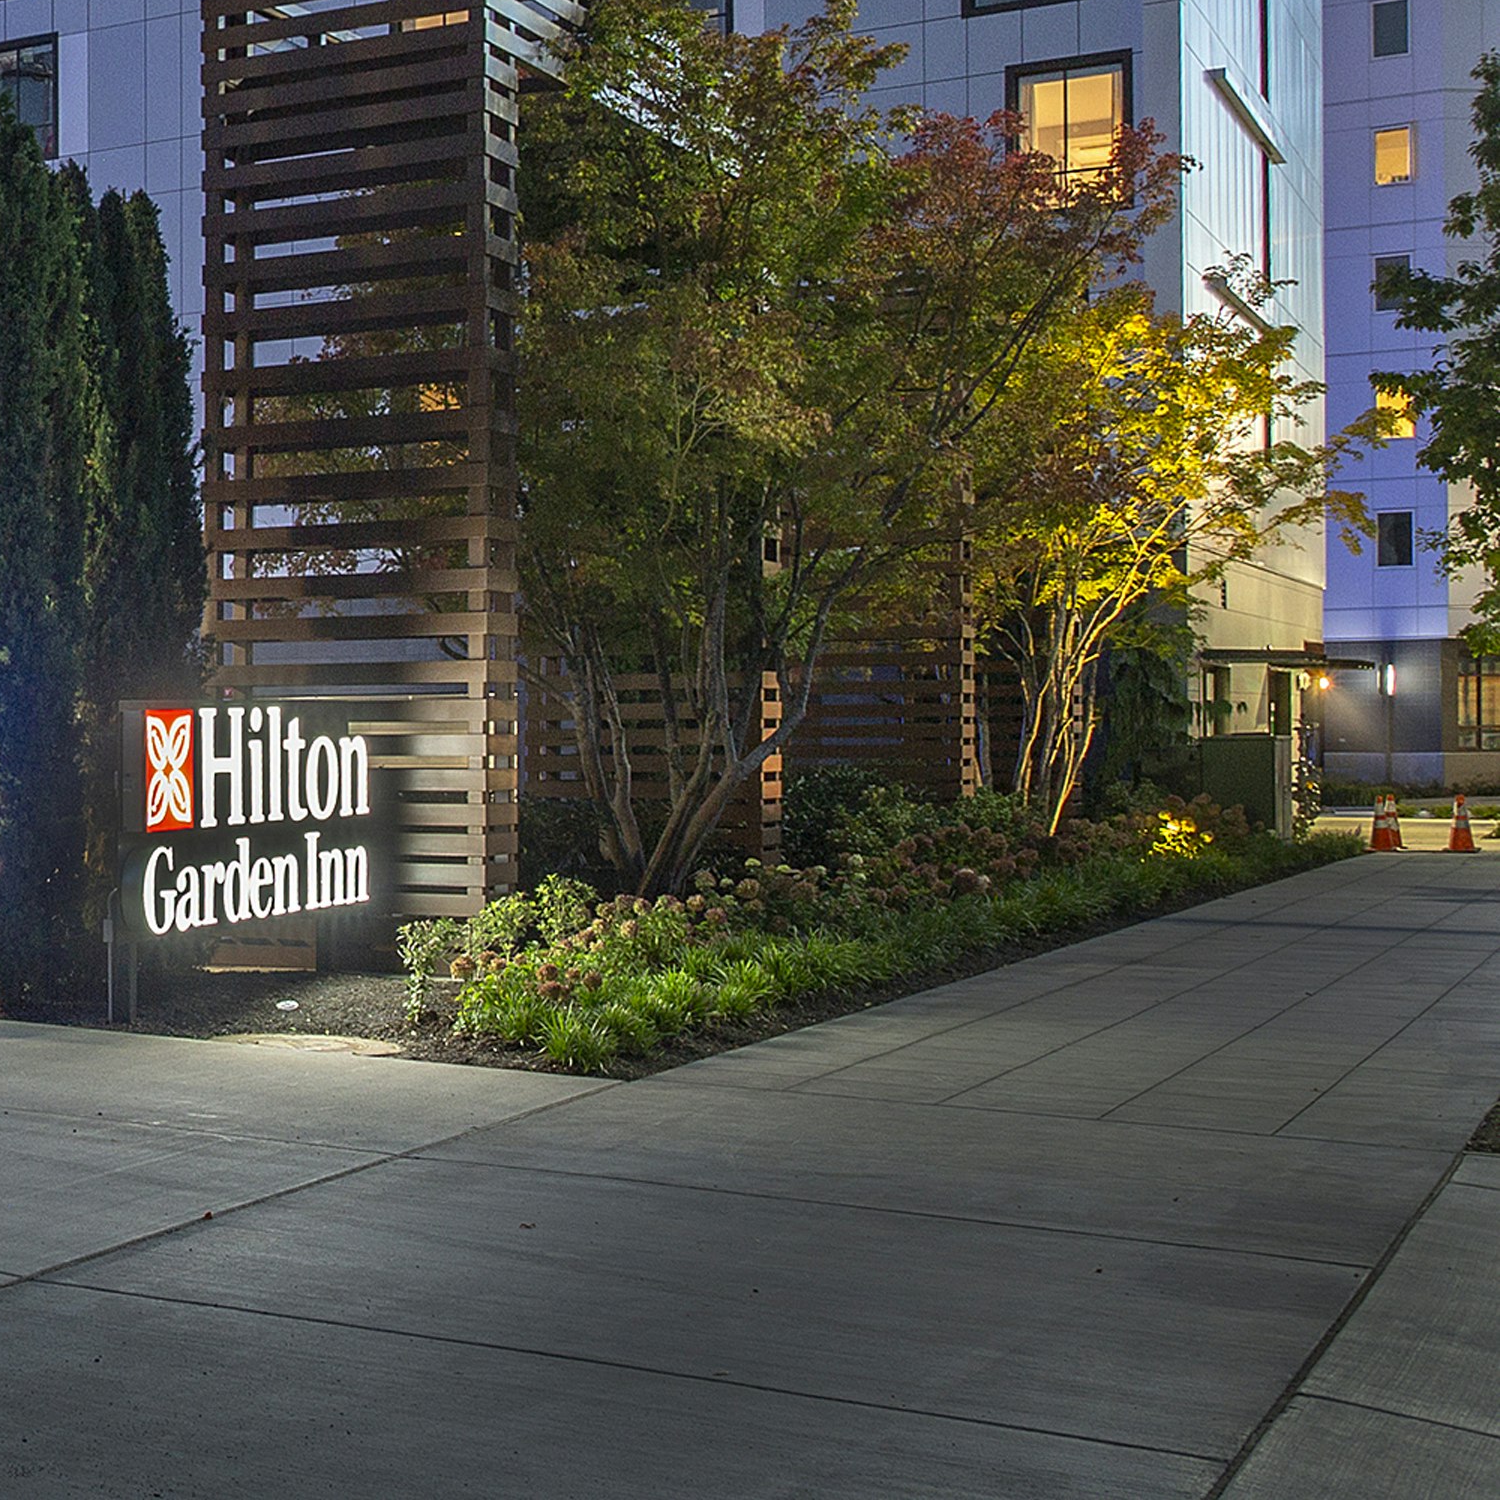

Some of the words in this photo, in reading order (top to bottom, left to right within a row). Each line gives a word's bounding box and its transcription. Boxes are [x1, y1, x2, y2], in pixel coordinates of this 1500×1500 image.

[198, 705, 370, 829] Hilton
[142, 837, 301, 935] Garden
[303, 831, 370, 912] Inn
